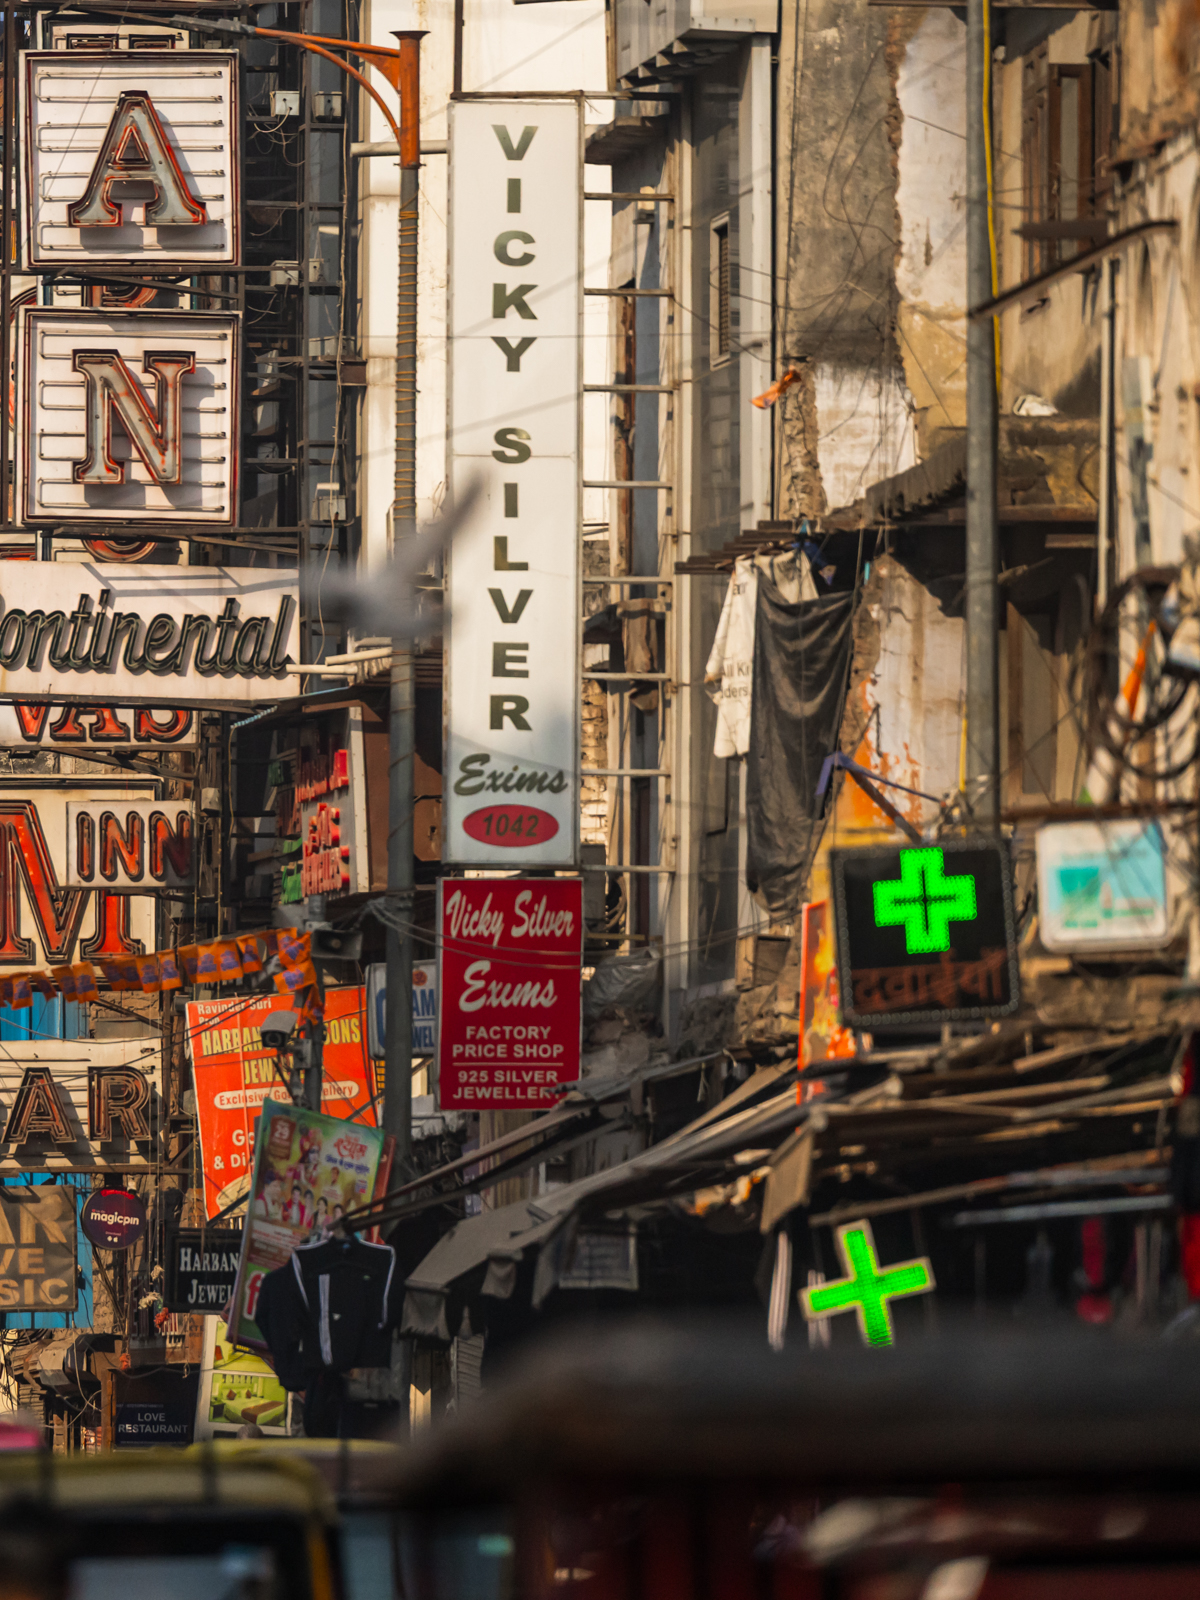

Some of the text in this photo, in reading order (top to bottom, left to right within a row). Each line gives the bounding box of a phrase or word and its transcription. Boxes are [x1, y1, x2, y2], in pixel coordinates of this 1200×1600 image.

[490, 124, 539, 373] VICKY
[487, 427, 534, 731] SILVER
[453, 753, 569, 796] Exims
[482, 812, 539, 838] 1042
[76, 811, 192, 878] INN
[446, 889, 575, 949] Vicky Silver
[197, 997, 272, 1016] Ravinder Suri
[201, 1026, 271, 1056] HARBAN
[466, 1025, 552, 1040] FACTORY
[452, 1044, 565, 1058] PRICE SHOP
[458, 1070, 558, 1083] 925 SILVER
[214, 1156, 225, 1170] &
[90, 1211, 140, 1226] magicpin
[179, 1247, 241, 1272] HARBAN
[137, 1412, 166, 1422] LOVE
[118, 1423, 188, 1434] RESTAURANT
